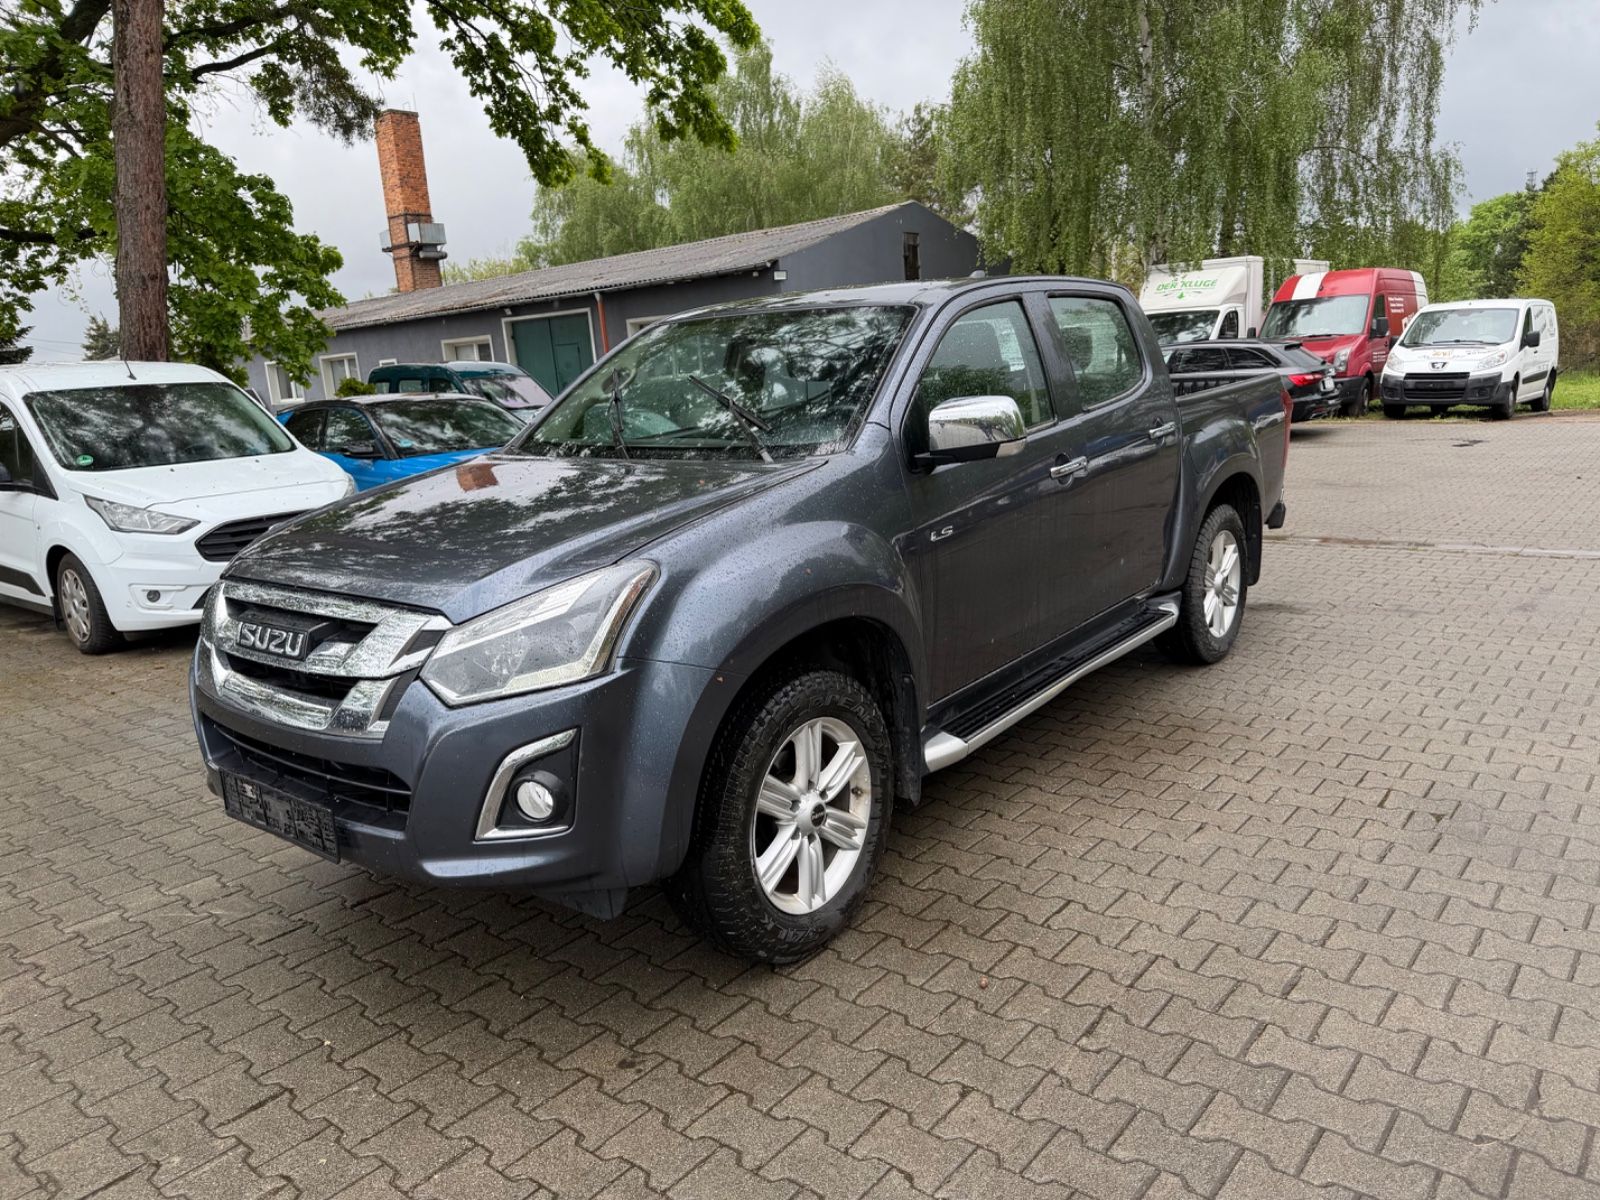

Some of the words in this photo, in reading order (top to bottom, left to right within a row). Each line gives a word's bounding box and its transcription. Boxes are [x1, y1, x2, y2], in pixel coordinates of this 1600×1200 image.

[1156, 280, 1178, 291] DER
[1180, 279, 1218, 289] KLUGE
[930, 525, 953, 542] LS
[237, 621, 304, 656] ISUZU
